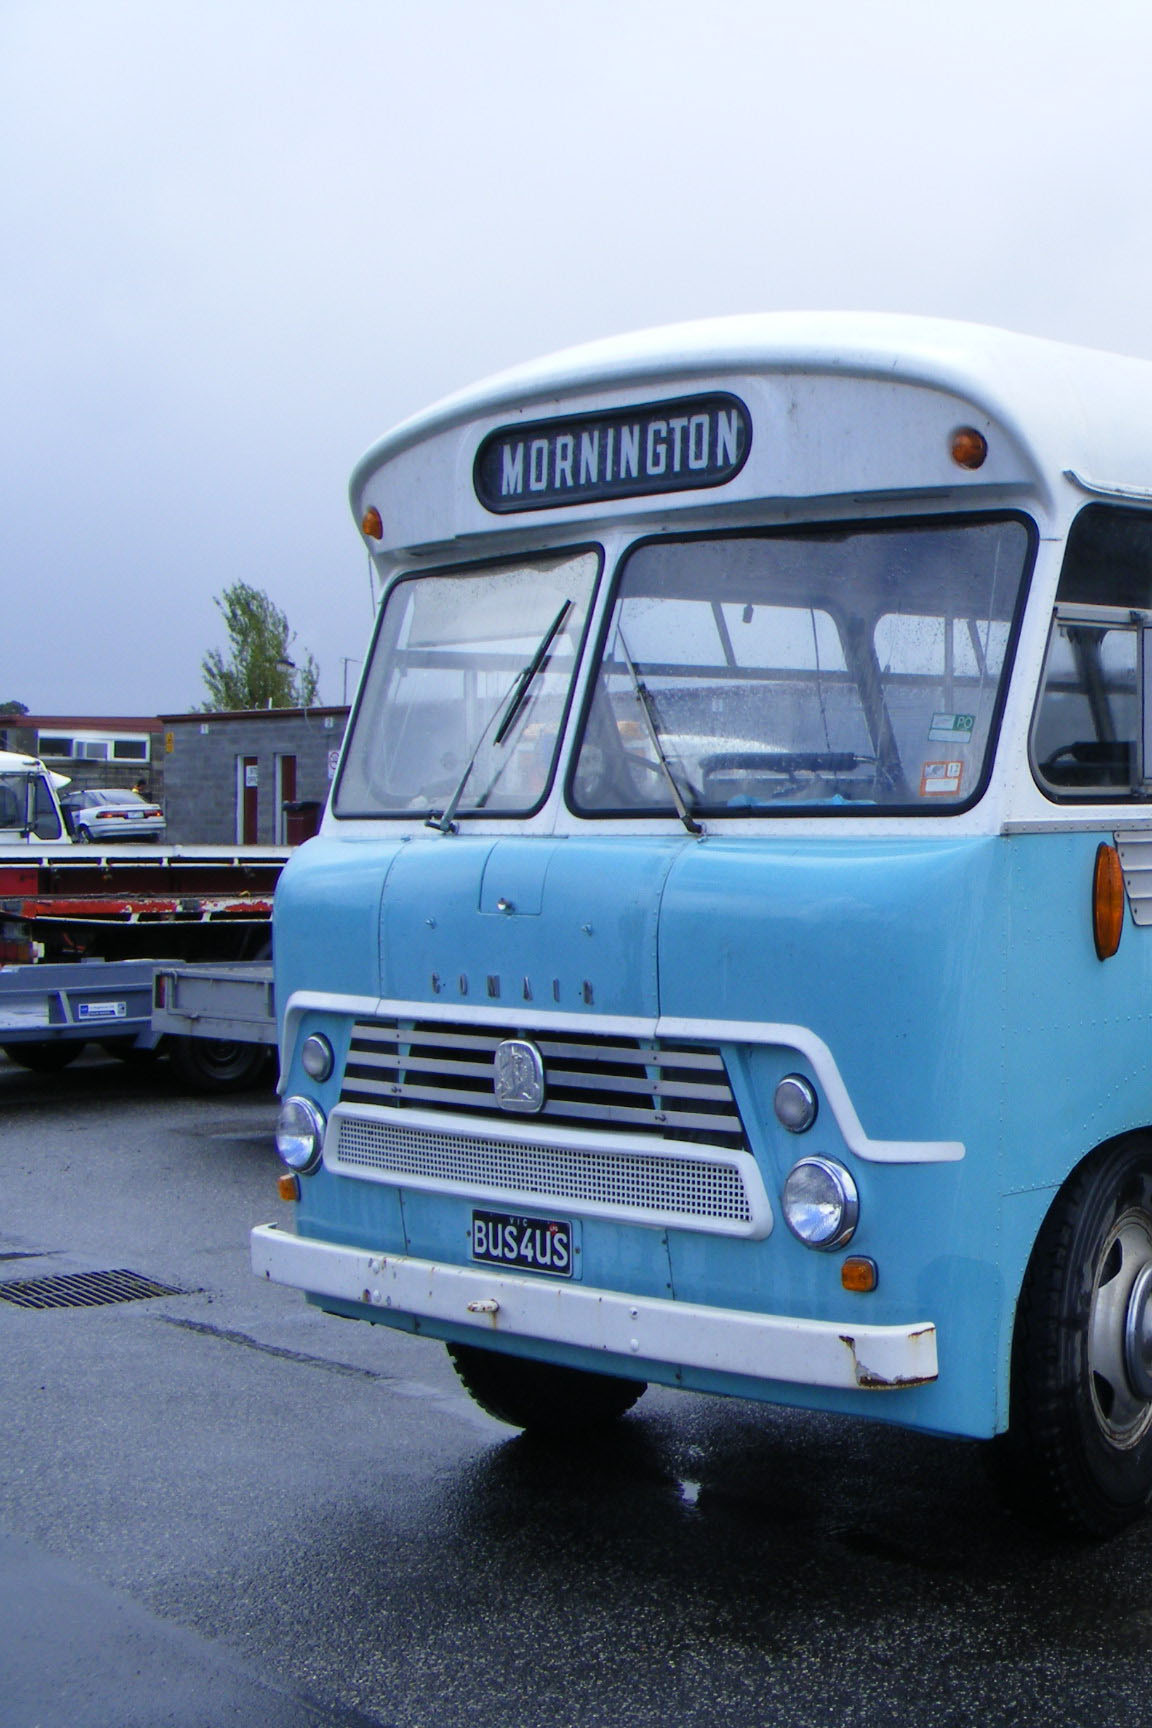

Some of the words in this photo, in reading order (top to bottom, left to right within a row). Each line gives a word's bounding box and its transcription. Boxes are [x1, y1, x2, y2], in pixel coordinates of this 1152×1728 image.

[501, 408, 739, 496] MORNINGTON
[474, 1219, 569, 1268] BUS4US
[509, 1216, 528, 1227] VIC
